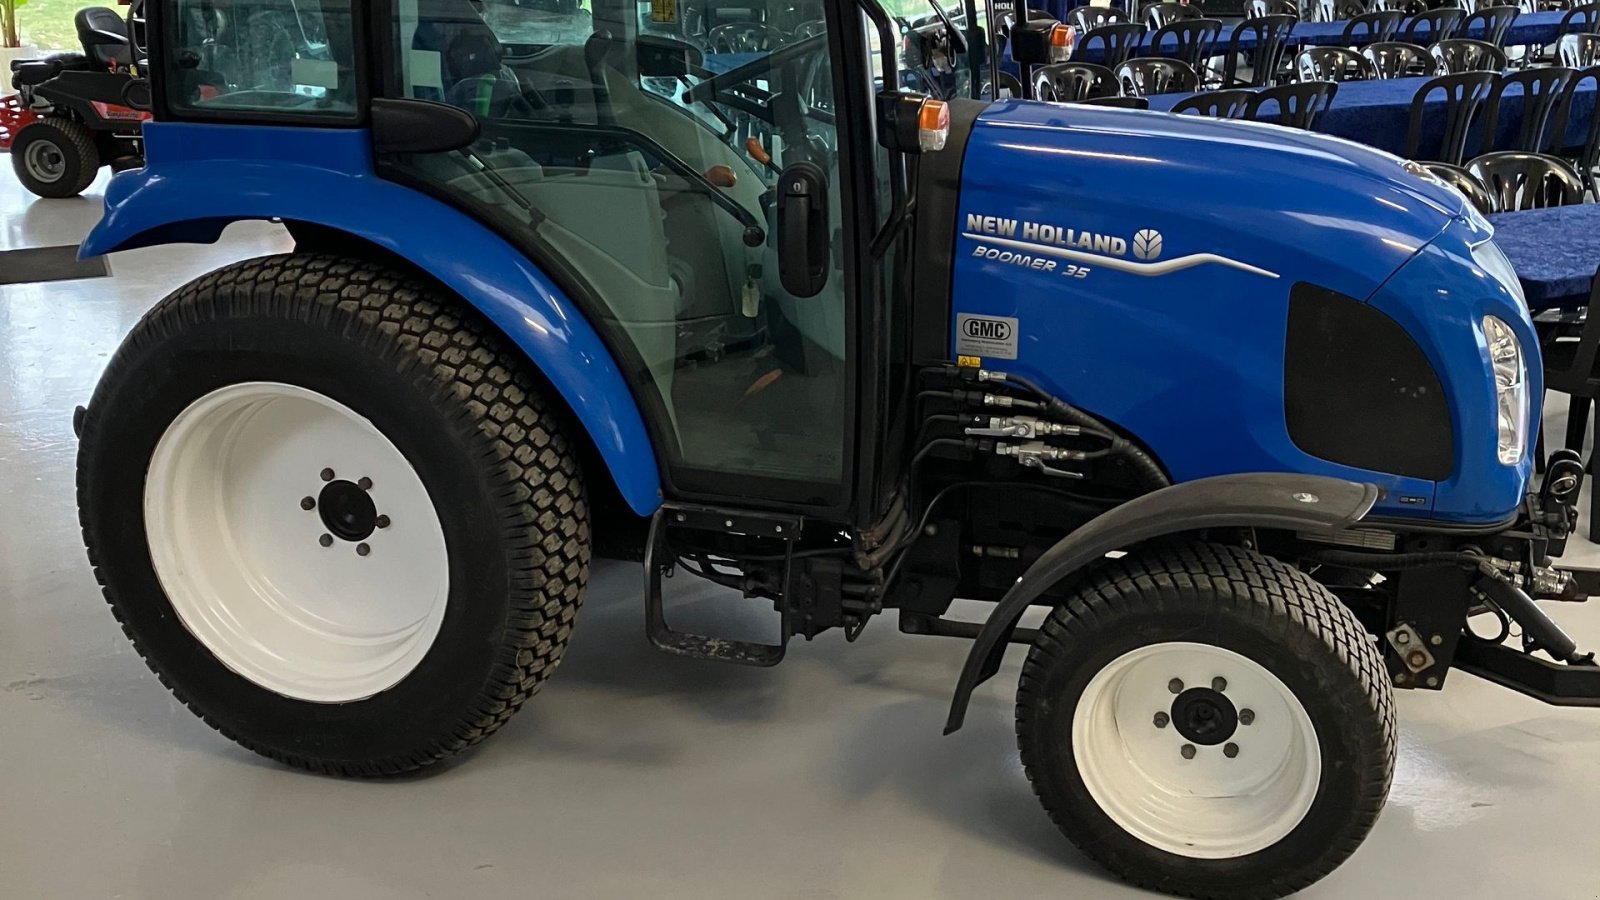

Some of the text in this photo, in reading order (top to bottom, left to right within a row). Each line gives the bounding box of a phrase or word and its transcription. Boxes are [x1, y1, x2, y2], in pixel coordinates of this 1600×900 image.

[966, 213, 1127, 256] NEW HOLLAND
[972, 245, 1091, 279] BOOMER 35
[969, 320, 1005, 338] GMC
